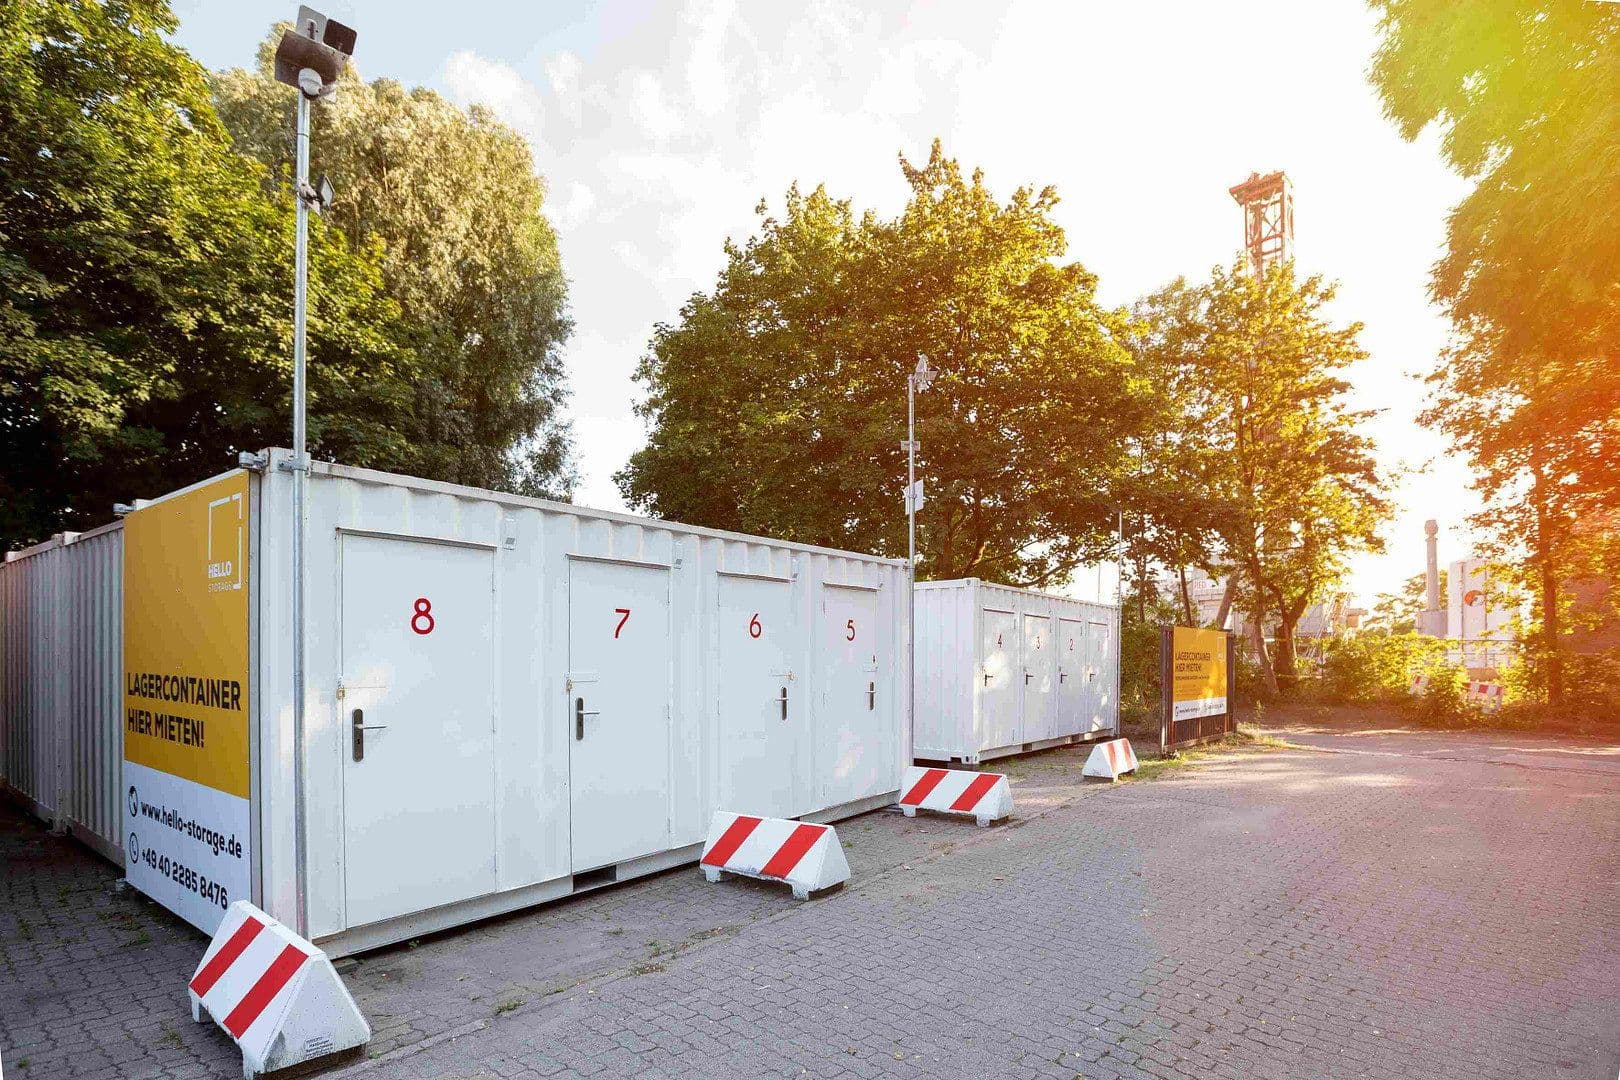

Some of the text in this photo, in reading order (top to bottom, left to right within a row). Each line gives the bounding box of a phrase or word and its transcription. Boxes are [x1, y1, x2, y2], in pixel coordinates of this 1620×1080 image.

[208, 561, 232, 578] HELLO
[411, 598, 435, 635] 8
[614, 608, 631, 639] 7
[749, 613, 761, 639] 6
[846, 619, 856, 641] 5
[997, 634, 1003, 648] 4
[1069, 638, 1075, 651] 2
[128, 672, 241, 711] LAGERCONTAINER
[128, 708, 204, 748] HIER MIETEN!
[140, 801, 242, 859] www.hello-storage.de
[142, 847, 228, 910] +49 40 2285 8476
